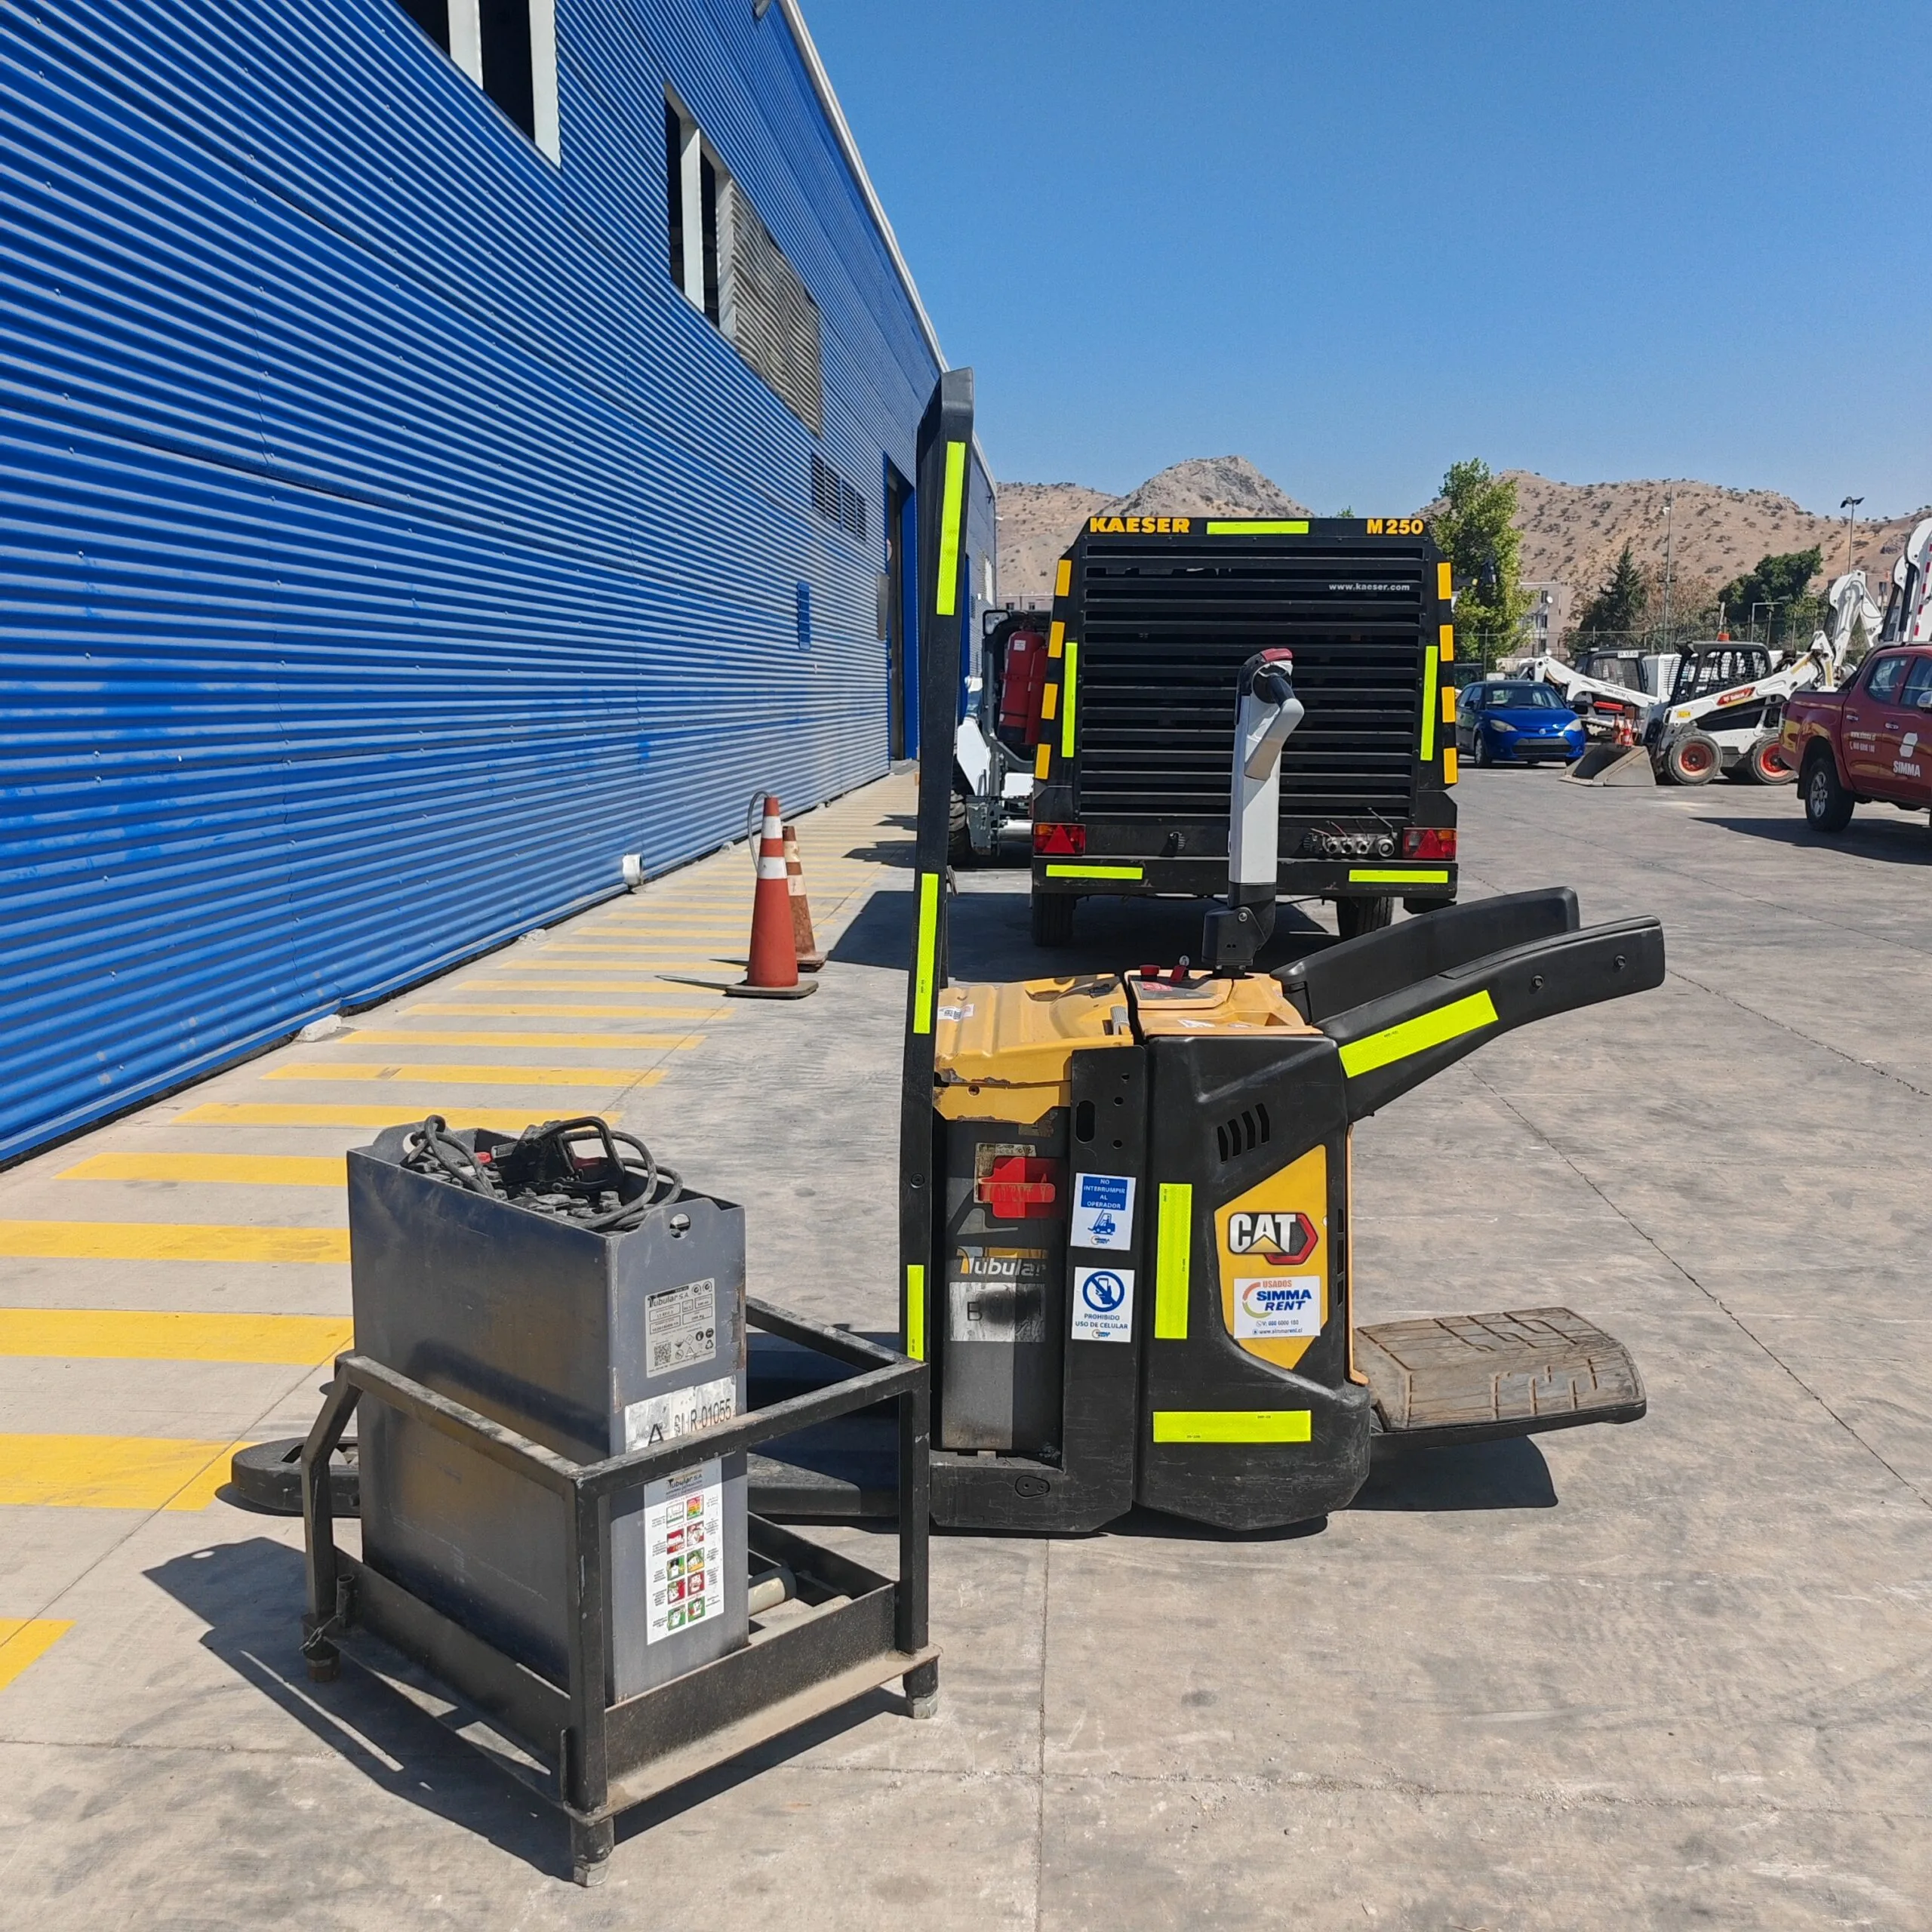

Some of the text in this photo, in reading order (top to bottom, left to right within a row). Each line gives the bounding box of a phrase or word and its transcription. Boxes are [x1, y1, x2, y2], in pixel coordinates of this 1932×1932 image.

[1089, 517, 1190, 534] KAESER
[1386, 519, 1424, 535] 250
[1328, 583, 1410, 591] www.kaeser.com
[1893, 760, 1921, 777] SIMMA
[1084, 1185, 1125, 1194] INTERRUMPIR
[1087, 1201, 1121, 1209] OPERADOR
[1229, 1214, 1297, 1254] CAT
[1263, 1280, 1292, 1288] USADOS
[648, 1294, 678, 1308] Tubular
[1257, 1289, 1312, 1301] SIMMA
[1264, 1300, 1306, 1312] RENT
